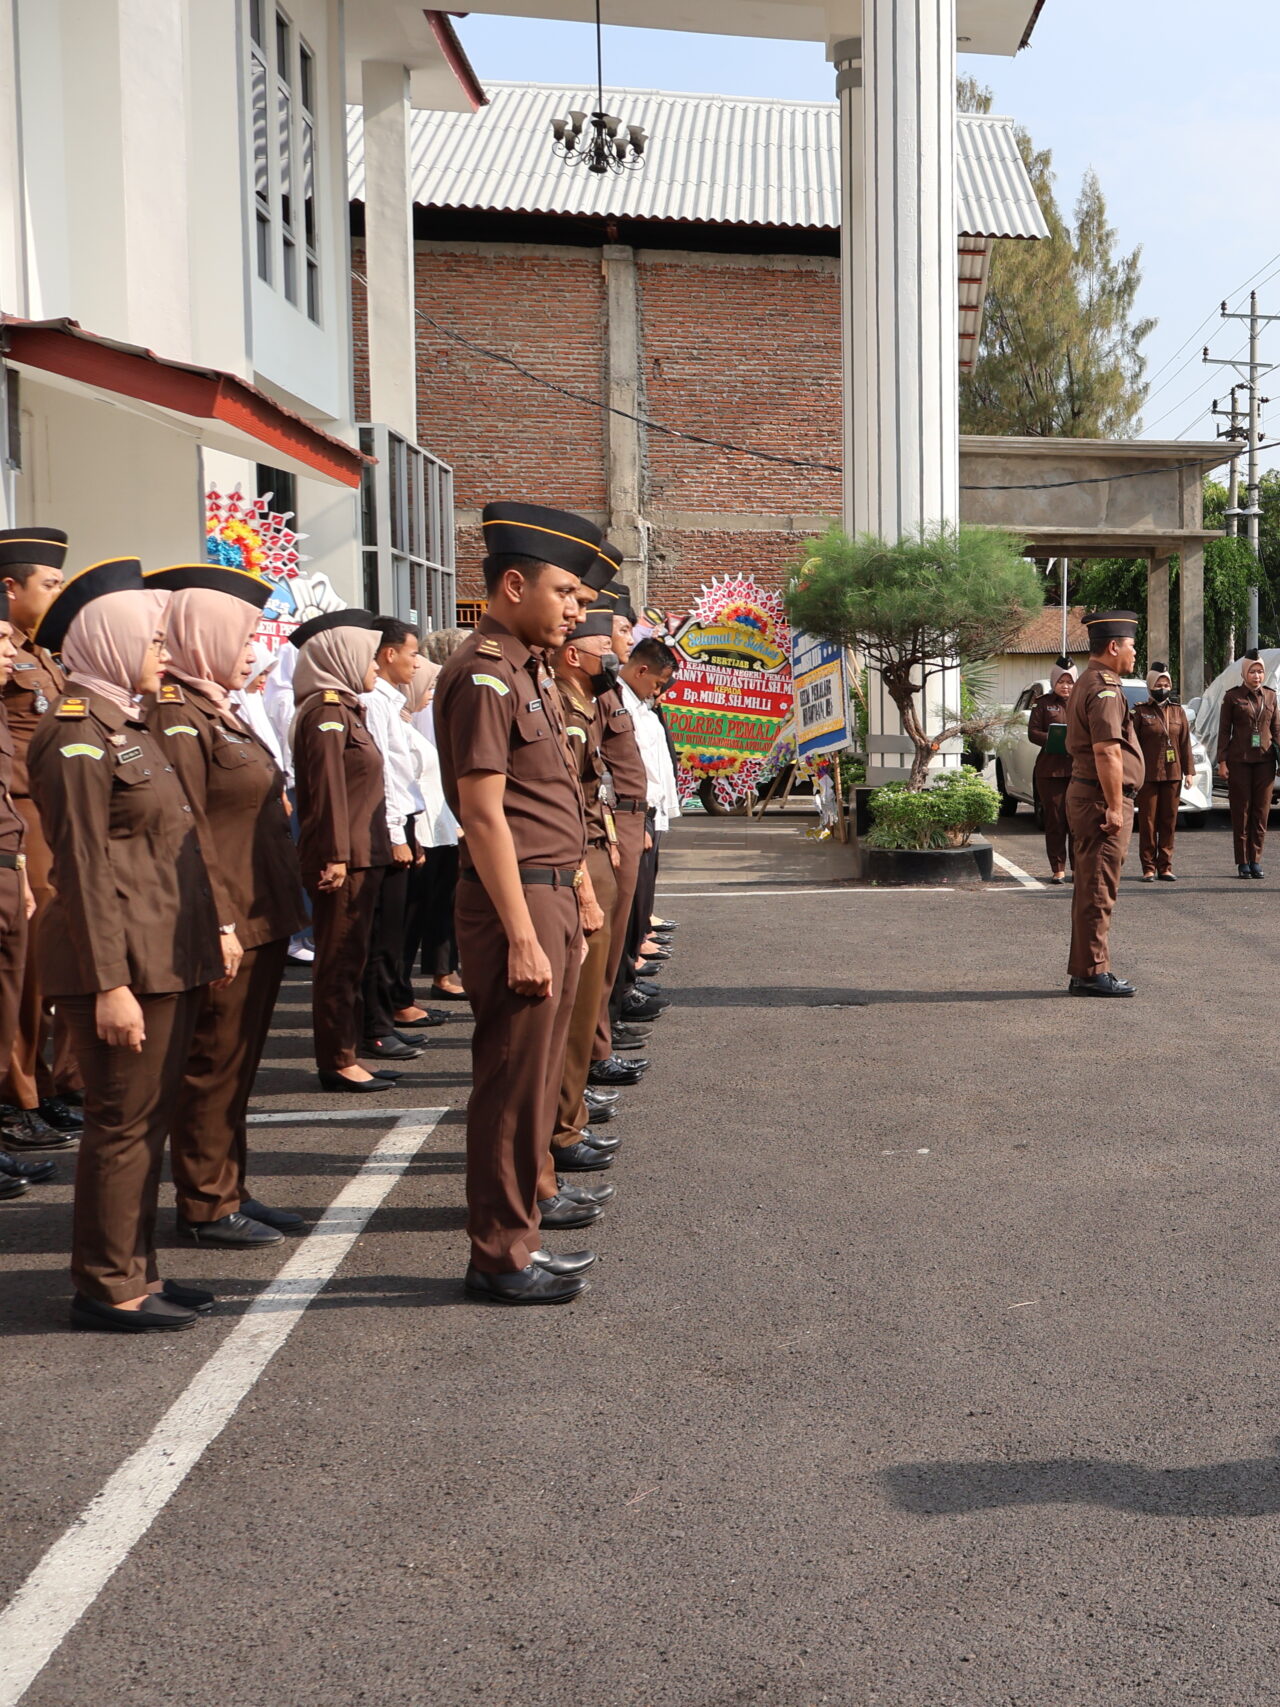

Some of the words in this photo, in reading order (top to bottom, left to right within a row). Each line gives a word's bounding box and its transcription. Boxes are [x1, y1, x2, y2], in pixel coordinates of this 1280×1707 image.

[688, 632, 731, 648] Selamat
[711, 656, 750, 668] SERTIJAB
[686, 661, 731, 675] KEJAKSAAN
[733, 669, 762, 680] NEGERI
[764, 672, 794, 683] PEMAL
[714, 685, 742, 695] KEPADA
